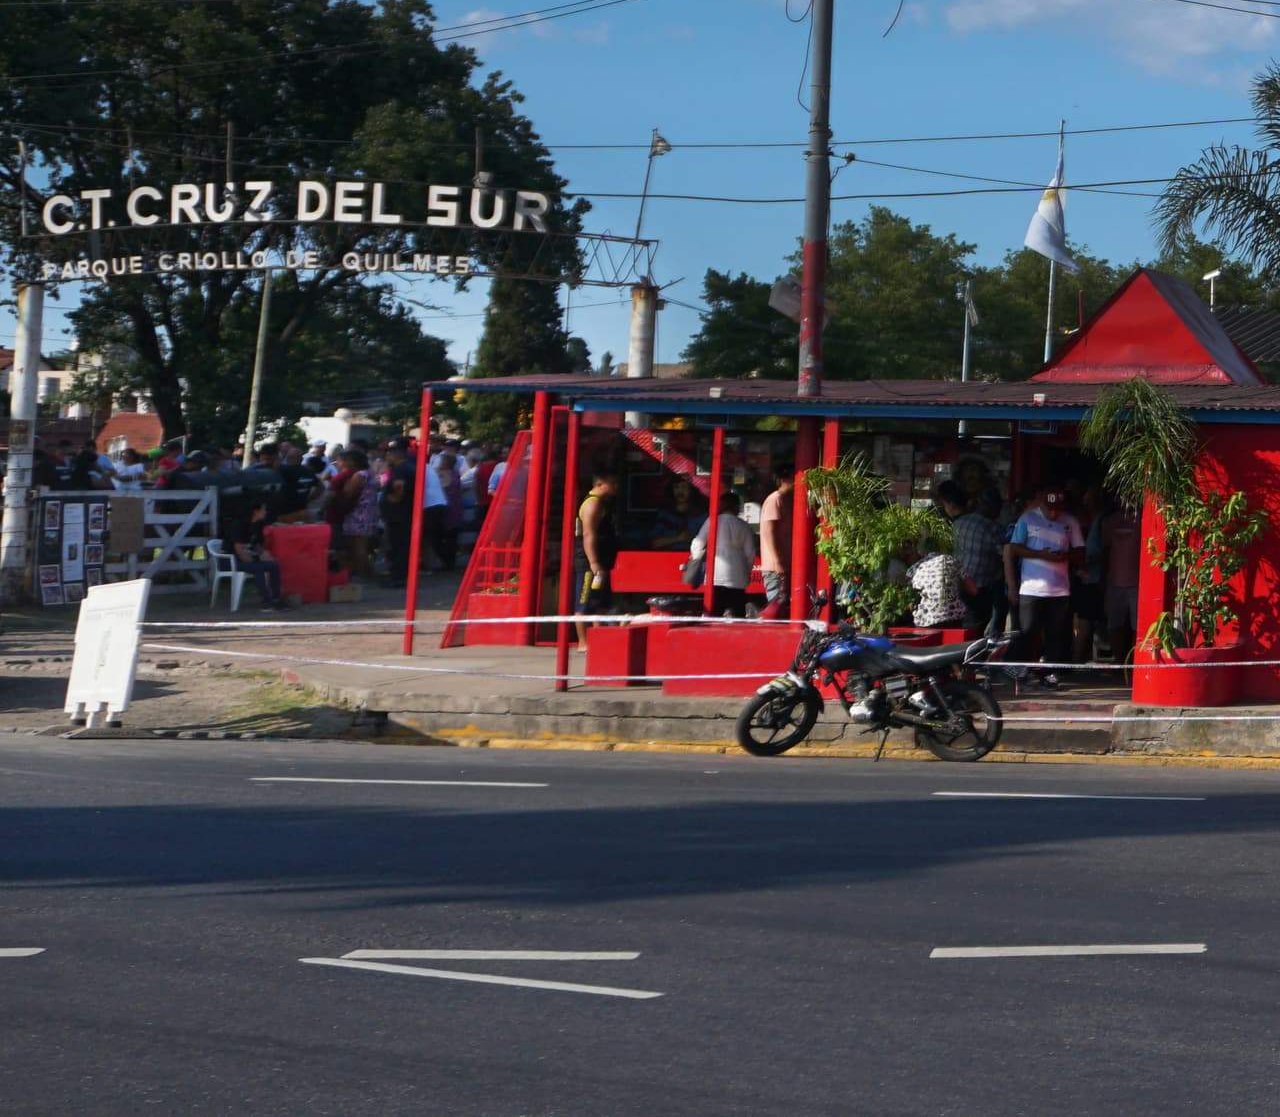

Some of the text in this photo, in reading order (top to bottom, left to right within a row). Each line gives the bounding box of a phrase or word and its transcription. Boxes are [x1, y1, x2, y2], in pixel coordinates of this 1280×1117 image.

[126, 181, 272, 226] CRUZ
[297, 181, 404, 224] DEL
[426, 184, 549, 232] SUR
[43, 250, 469, 283] PARQUE CRIOLLO DE QUILMES
